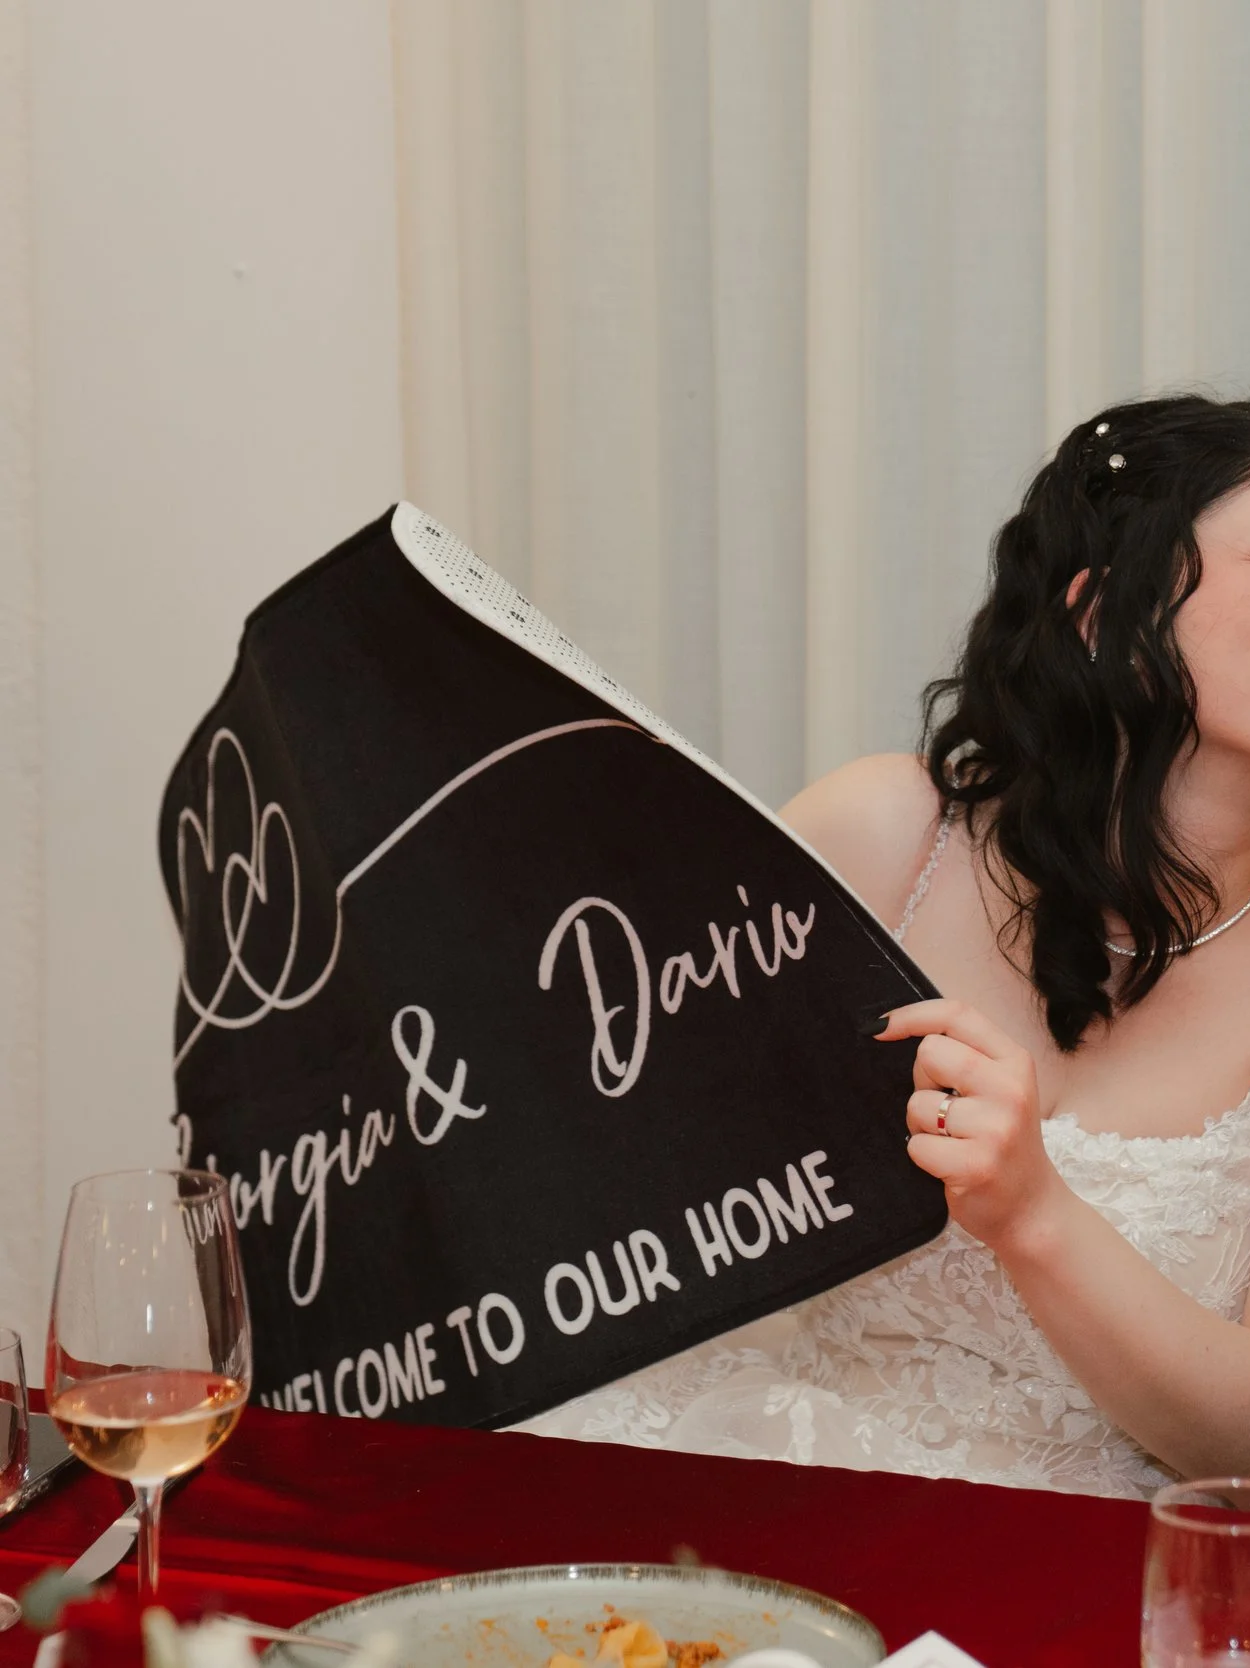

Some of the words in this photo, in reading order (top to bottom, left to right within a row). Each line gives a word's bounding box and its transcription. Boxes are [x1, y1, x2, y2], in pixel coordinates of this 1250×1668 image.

[392, 1005, 487, 1145] &
[539, 885, 816, 1097] Dario
[447, 1292, 525, 1377] TO
[544, 1229, 681, 1336] OUR
[685, 1150, 853, 1277] HOME
